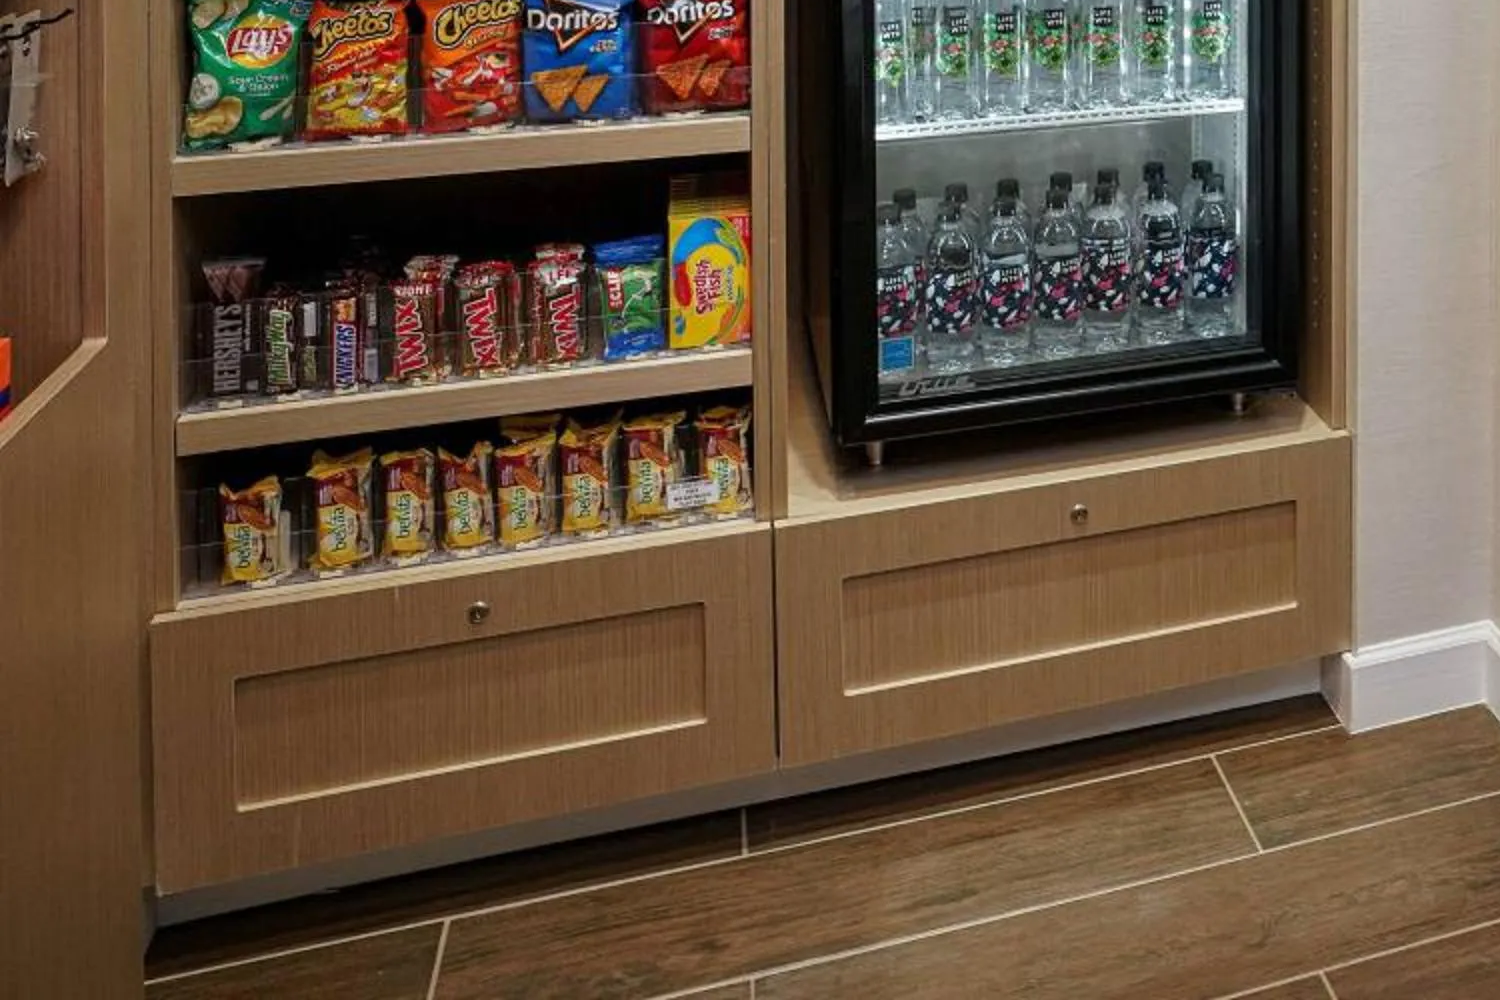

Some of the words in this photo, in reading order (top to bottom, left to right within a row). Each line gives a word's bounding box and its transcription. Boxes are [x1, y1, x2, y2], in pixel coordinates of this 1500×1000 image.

[232, 24, 290, 58] Lay's
[528, 9, 617, 31] Doritos
[213, 303, 242, 392] HERSHEY'S
[393, 296, 429, 377] TWIX
[464, 287, 502, 366] TWIX
[549, 284, 584, 360] TWIX
